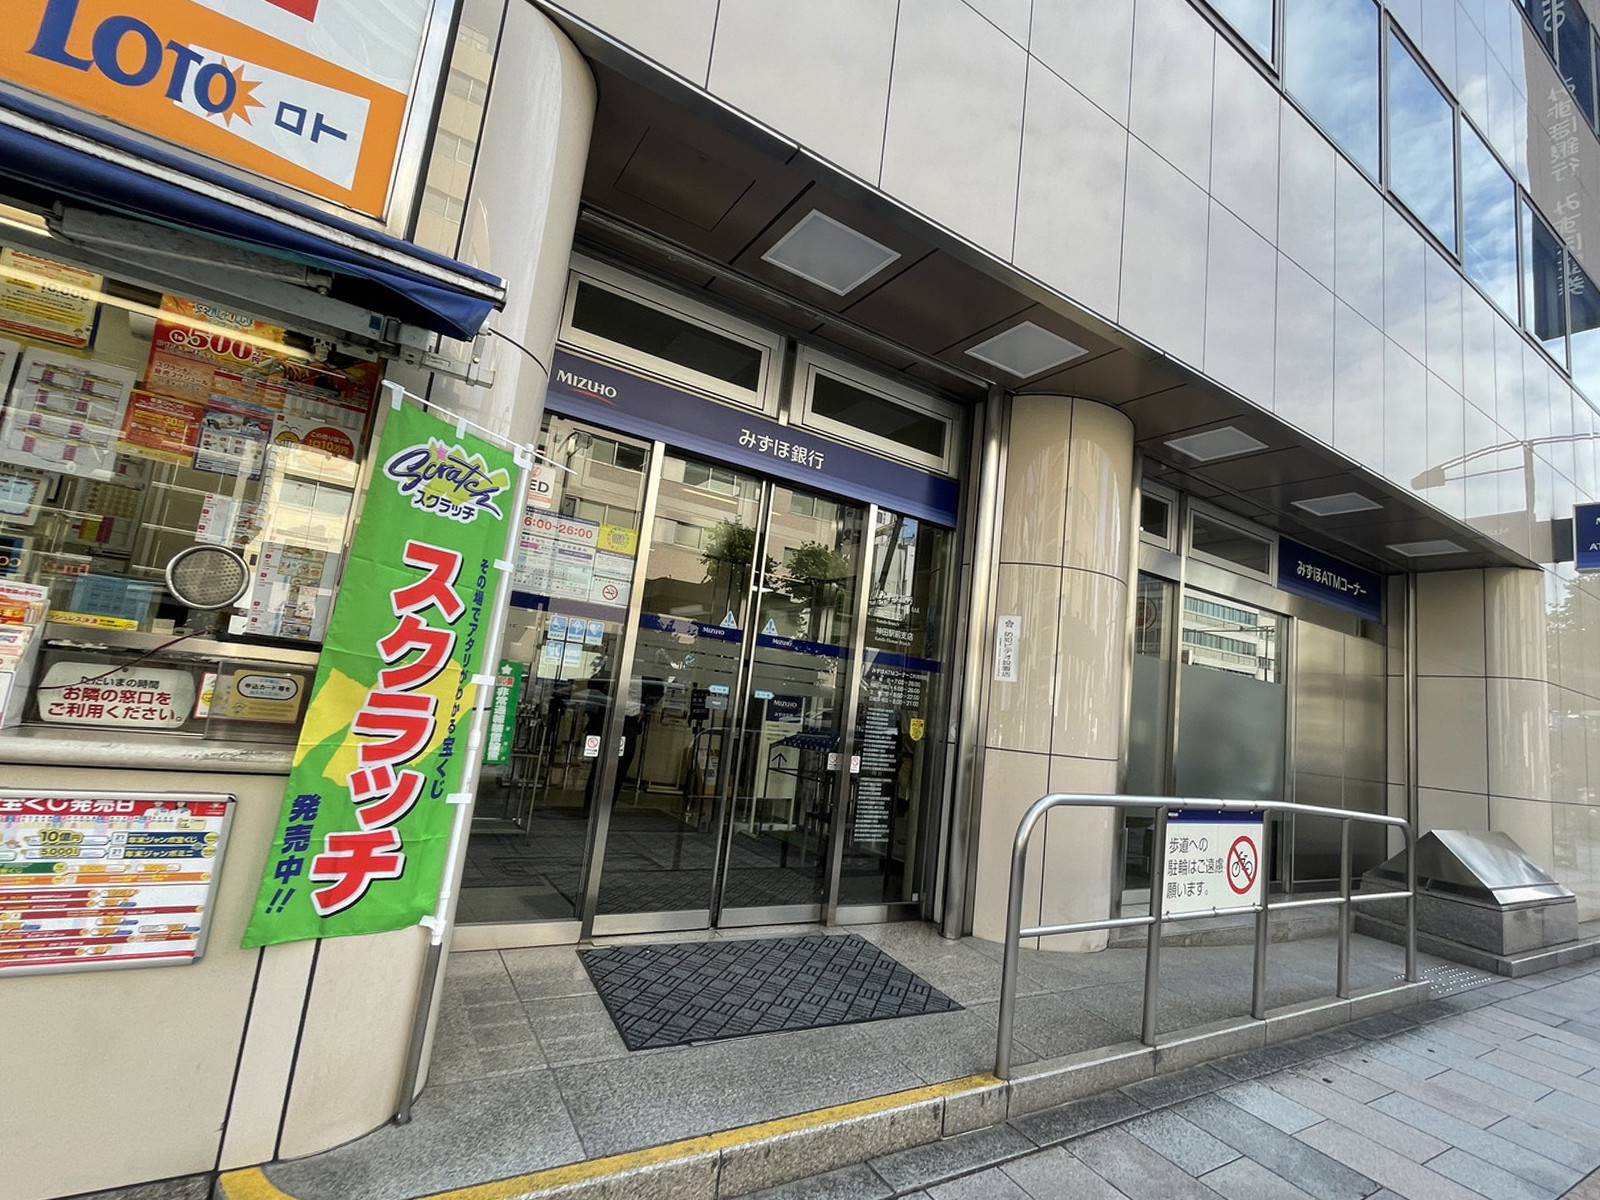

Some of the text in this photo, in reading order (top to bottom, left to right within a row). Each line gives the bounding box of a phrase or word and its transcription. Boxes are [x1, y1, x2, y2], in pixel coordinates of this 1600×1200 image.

[26, 0, 237, 114] LOTO
[274, 101, 348, 144] ロト
[556, 369, 618, 399] MIZUHO
[739, 428, 824, 469] みずほ銀行
[388, 447, 502, 517] Scratch
[529, 478, 550, 493] ED
[414, 490, 475, 520] スクラッチ
[1297, 560, 1367, 596] みずほATMコーナー
[80, 675, 160, 690] ただいまの時間
[430, 559, 488, 800] その場でアタリがわかる宝くじ
[62, 687, 171, 706] お隣の窓口を
[773, 700, 798, 709] MIZUHO
[47, 702, 182, 722] ご利用ください。
[312, 541, 466, 914] スクラッチ
[1169, 836, 1208, 854] 歩道への
[1168, 857, 1224, 876] 駐輪はご遠慮
[1166, 881, 1208, 899] 願います。
